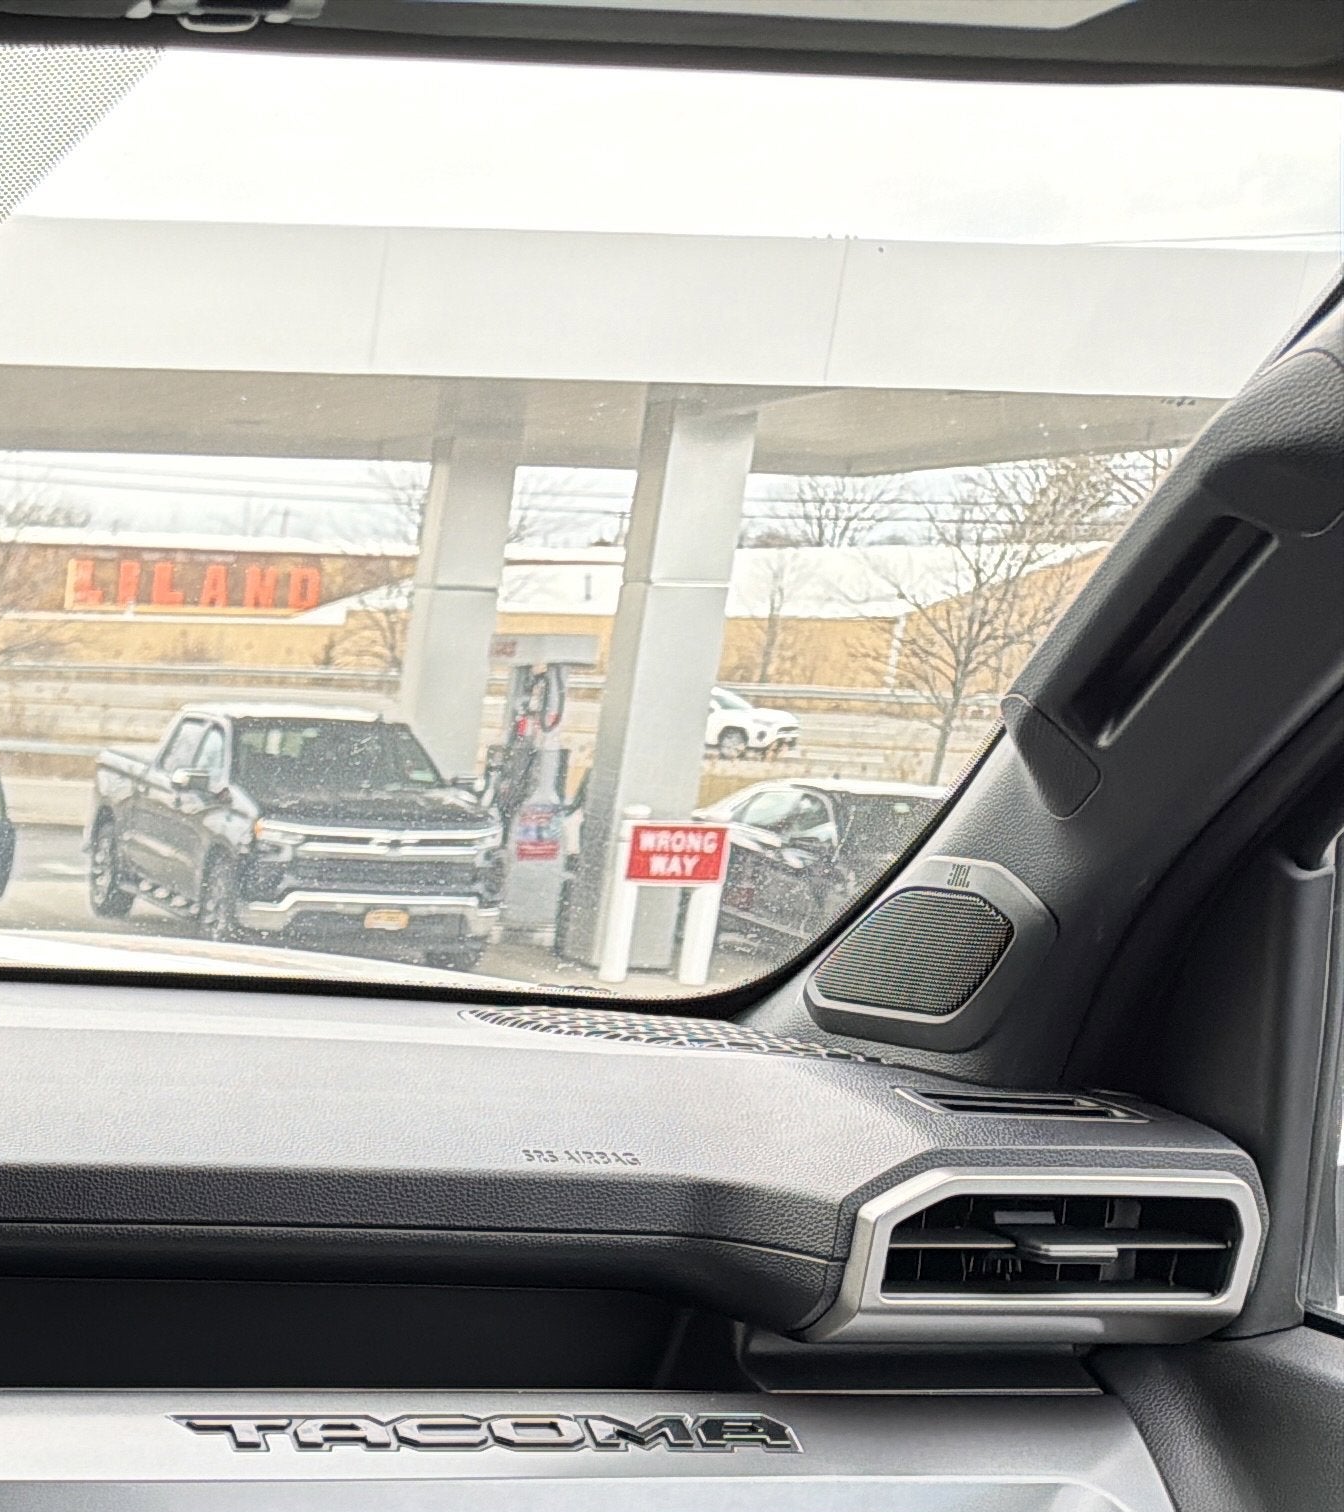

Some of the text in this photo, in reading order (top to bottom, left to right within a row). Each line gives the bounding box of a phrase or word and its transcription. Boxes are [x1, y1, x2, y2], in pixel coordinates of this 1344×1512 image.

[638, 829, 719, 854] WRONG
[648, 854, 701, 877] WAY
[947, 863, 972, 889] JBL
[168, 1414, 800, 1453] TACOMA
